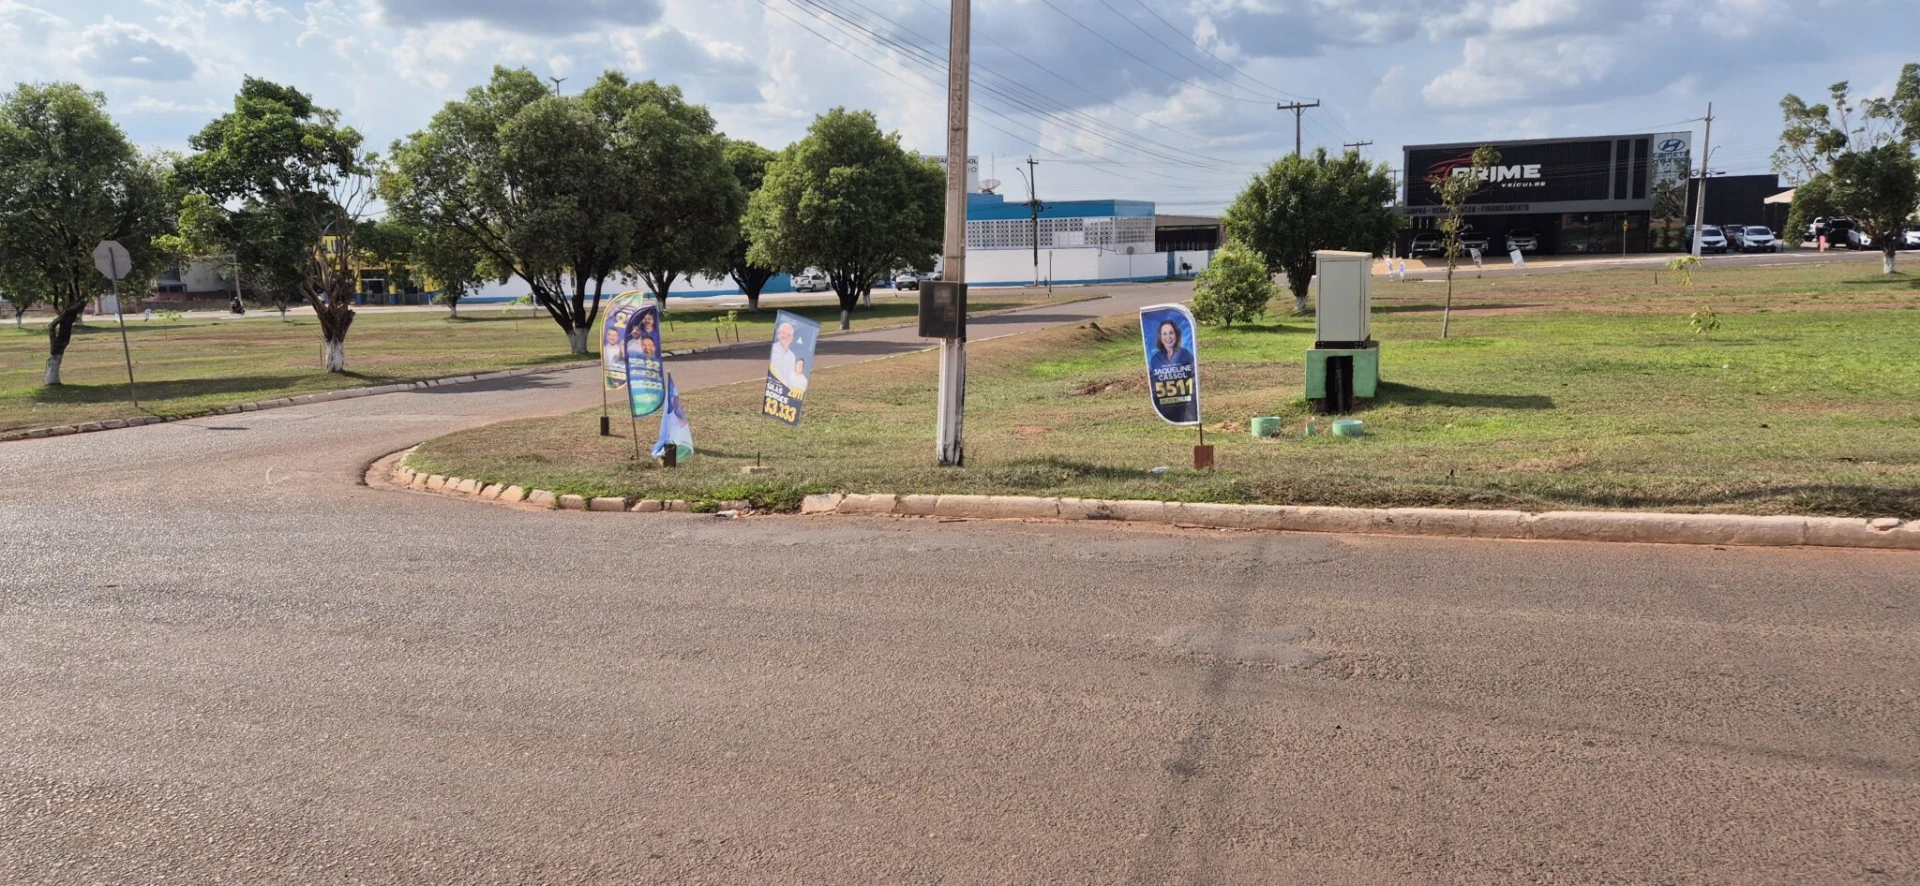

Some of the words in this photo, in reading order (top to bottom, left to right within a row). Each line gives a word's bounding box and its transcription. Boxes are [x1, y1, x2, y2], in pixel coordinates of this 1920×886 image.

[1452, 164, 1541, 182] PRIME
[1481, 204, 1529, 213] FINANCIAMENTO
[1154, 364, 1192, 376] JAQUELINE
[1158, 372, 1188, 381] CASSOL
[766, 382, 784, 395] SILAS
[1155, 378, 1193, 398] 5511
[765, 389, 789, 404] BORGES
